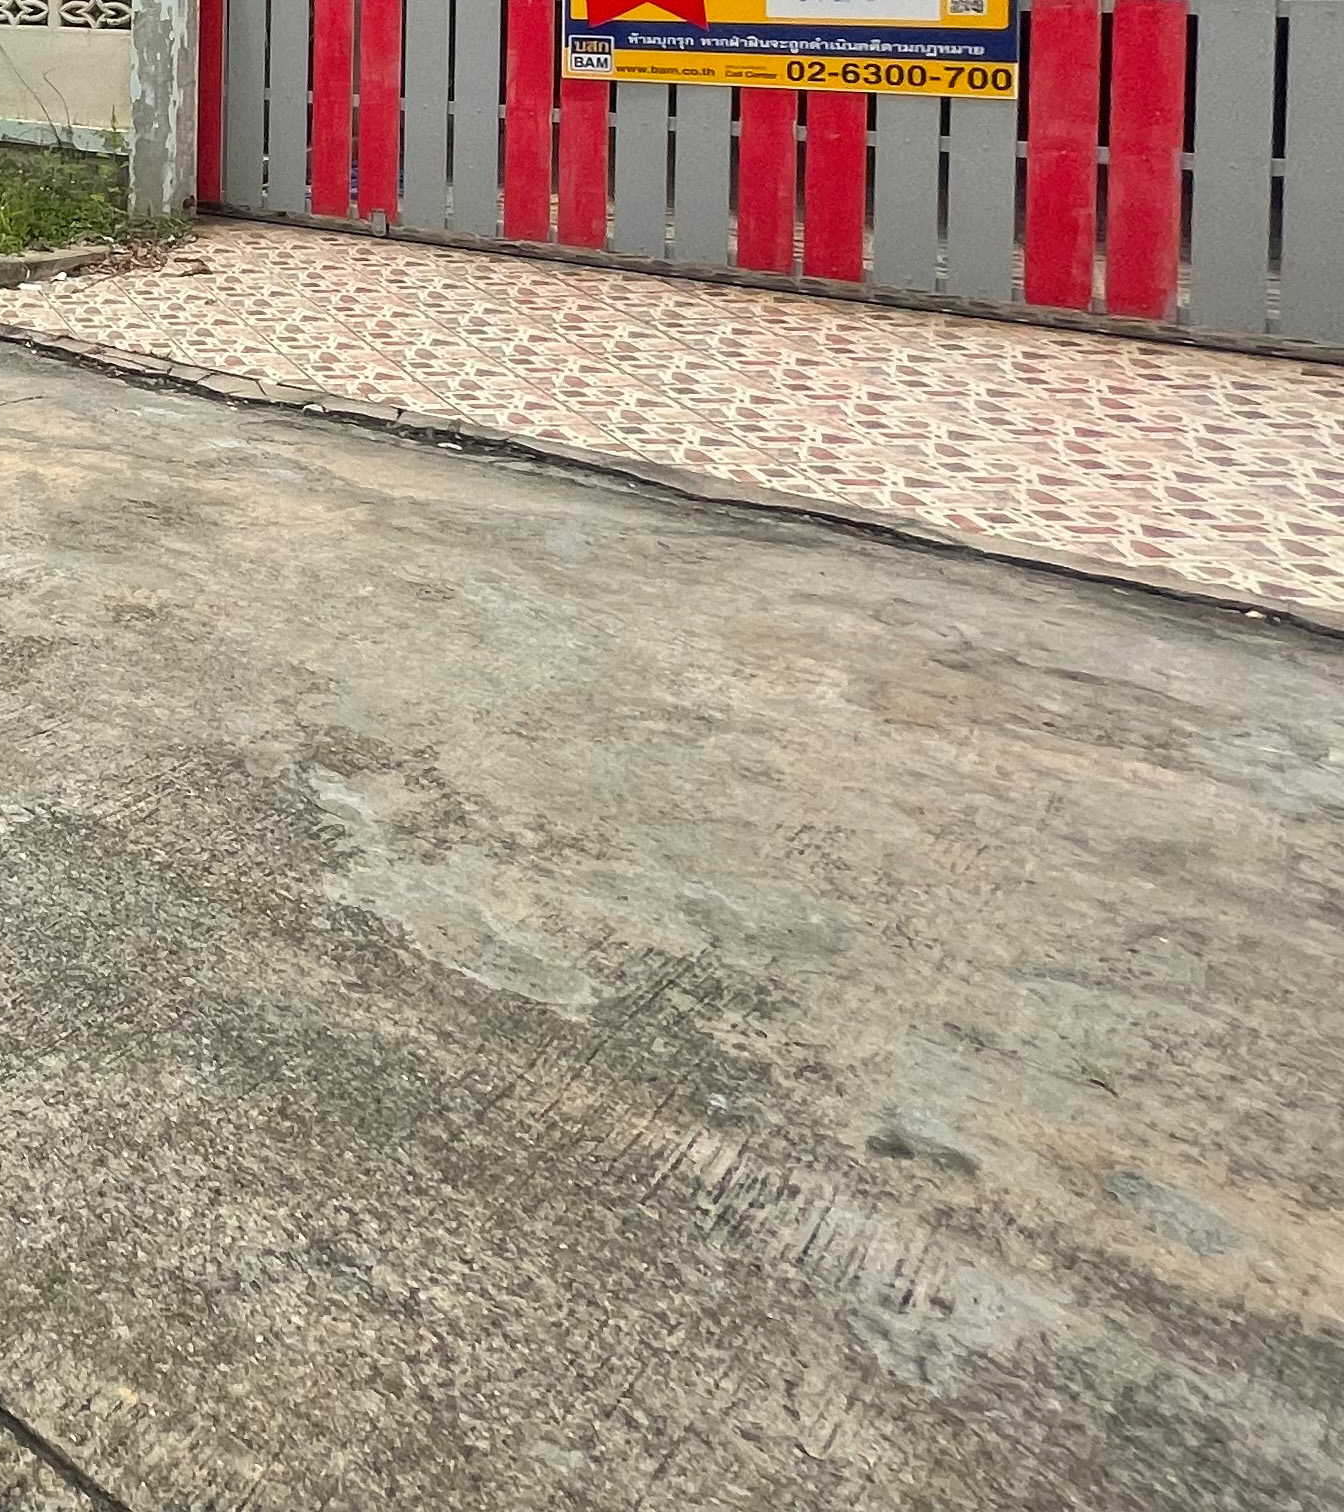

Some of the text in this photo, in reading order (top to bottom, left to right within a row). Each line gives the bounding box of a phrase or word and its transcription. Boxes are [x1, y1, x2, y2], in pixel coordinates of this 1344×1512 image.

[573, 40, 610, 53] บสก
[573, 56, 609, 69] BAM
[616, 64, 716, 77] www.bam.co.th
[786, 60, 1012, 91] 02-6300-700
